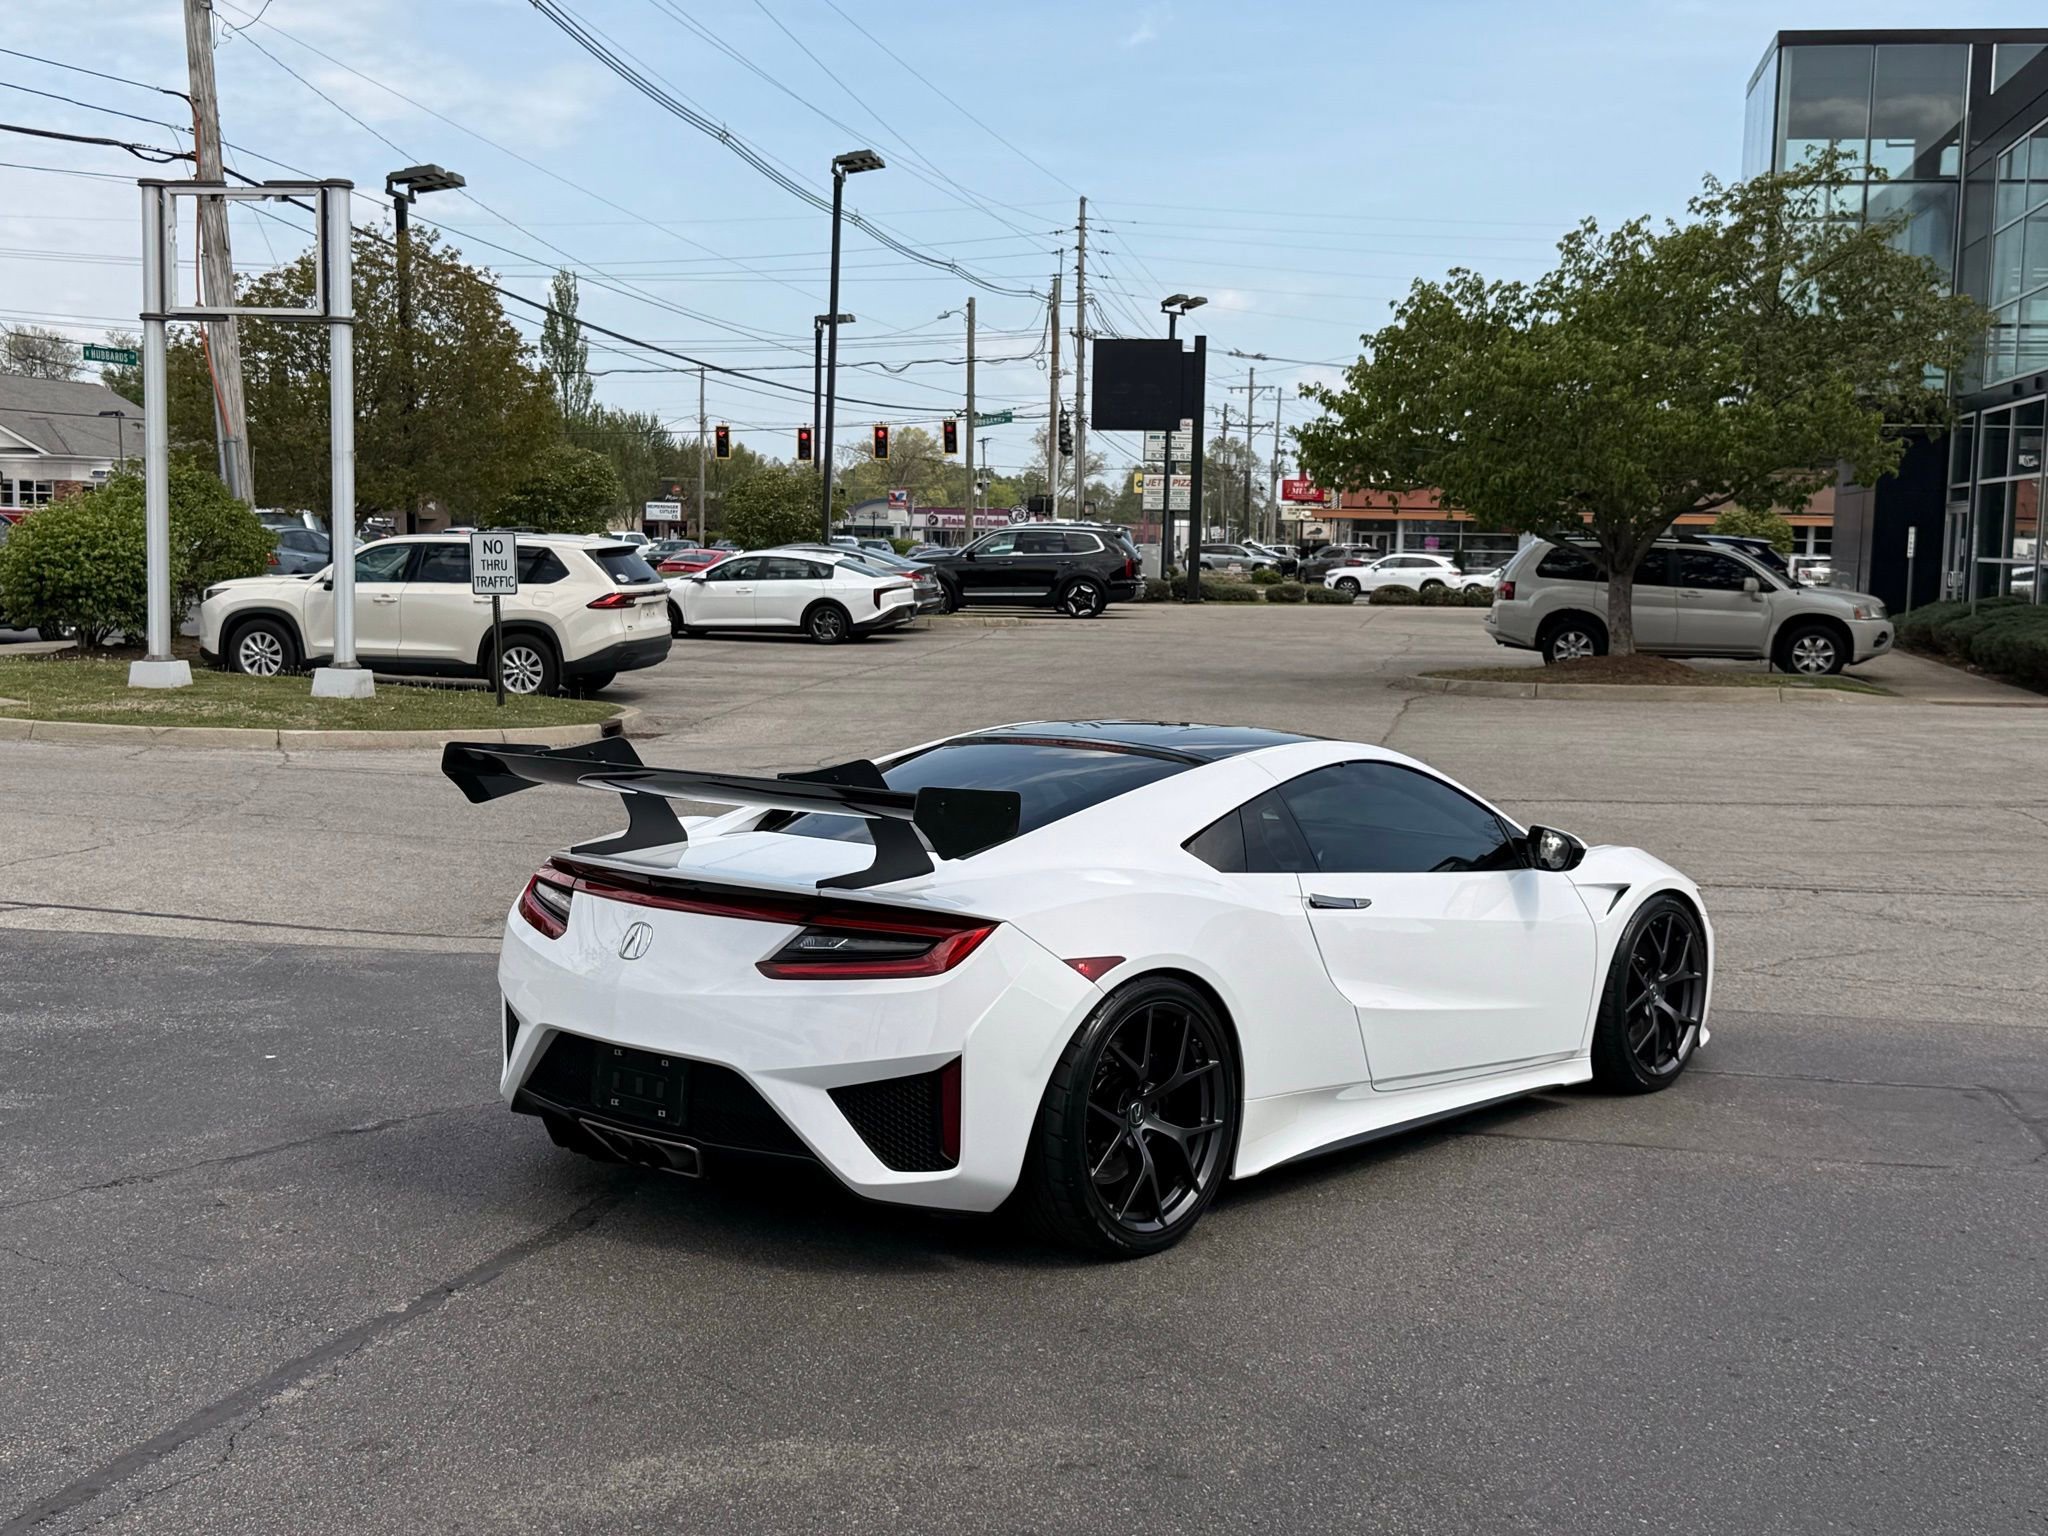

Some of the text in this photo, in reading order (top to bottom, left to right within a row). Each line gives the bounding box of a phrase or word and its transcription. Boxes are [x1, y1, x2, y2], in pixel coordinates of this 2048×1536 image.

[91, 349, 128, 363] HUBBARDS
[1172, 479, 1192, 487] PIZZ
[483, 539, 503, 554] NO
[481, 559, 507, 571] THRU
[475, 575, 515, 588] TRAFFIC
